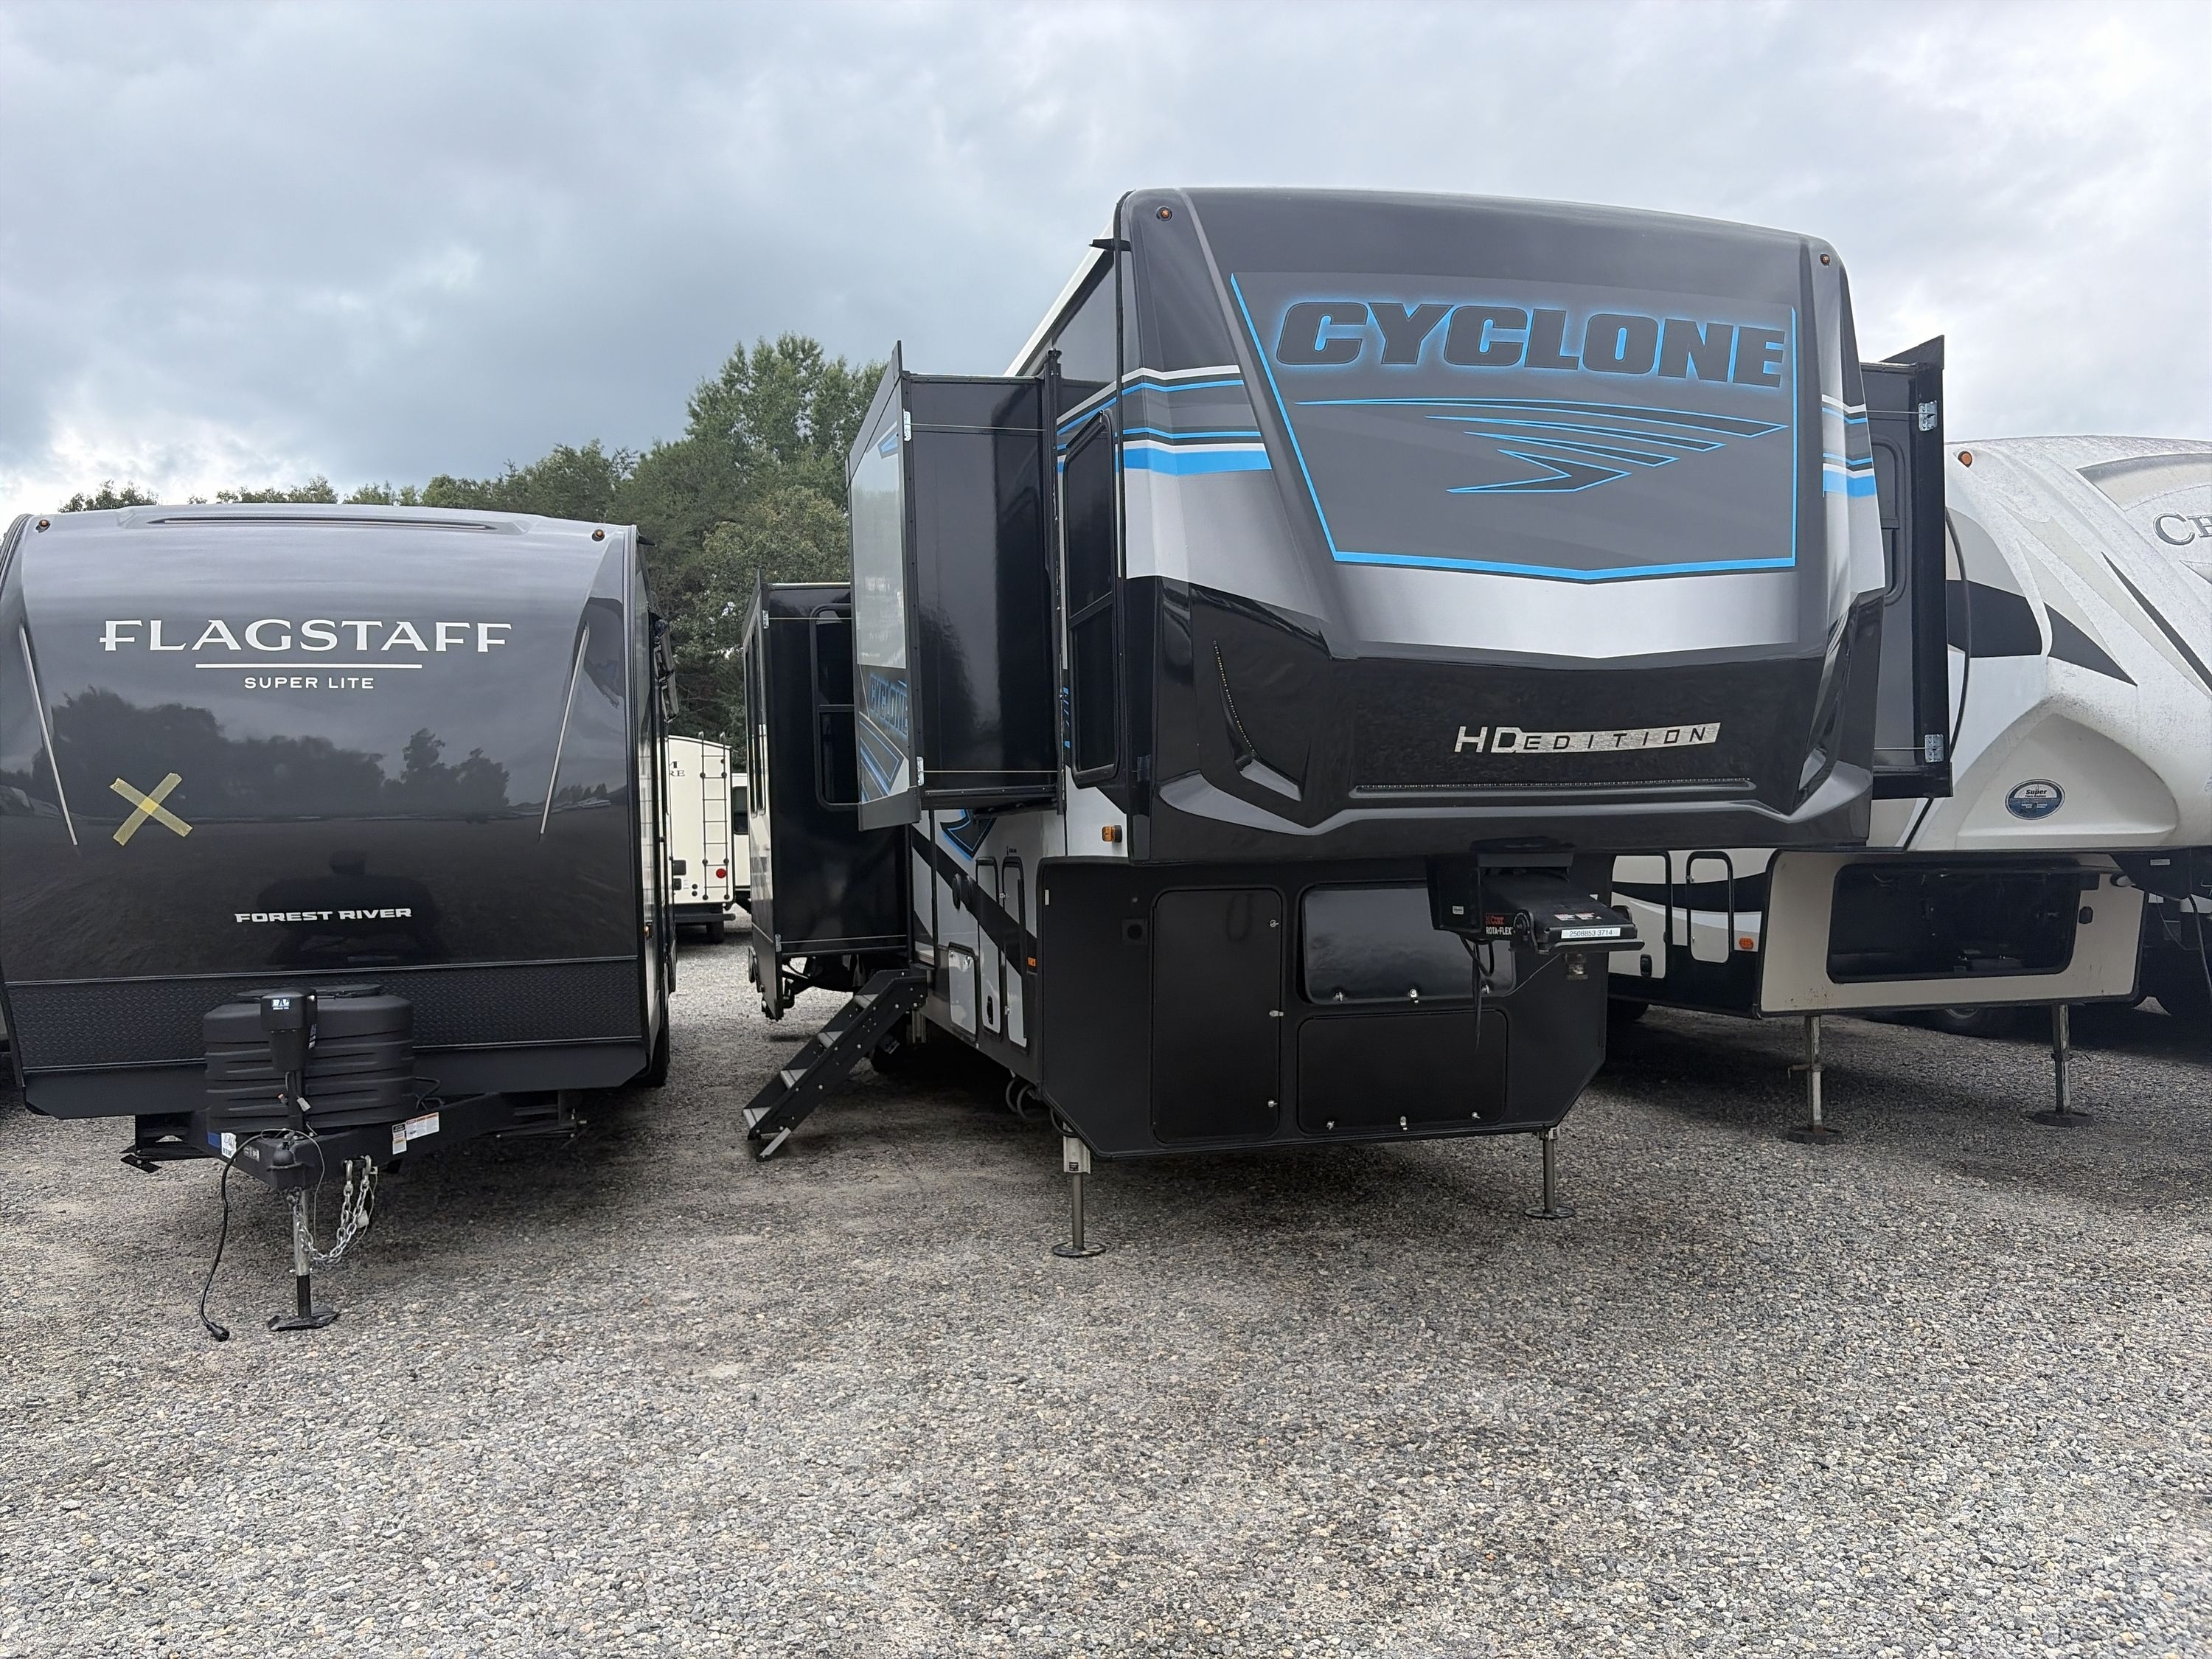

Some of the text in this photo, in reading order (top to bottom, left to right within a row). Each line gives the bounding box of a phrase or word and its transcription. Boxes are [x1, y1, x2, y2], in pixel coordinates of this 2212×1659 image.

[1276, 302, 1786, 388] CYCLONE
[99, 619, 512, 653] FLAGSTAFF
[244, 676, 374, 689] SUPER LITE
[1454, 726, 1706, 753] HD EDITION
[234, 908, 413, 923] FOREST RIVER
[1486, 926, 1512, 936] ROTA-FLEX
